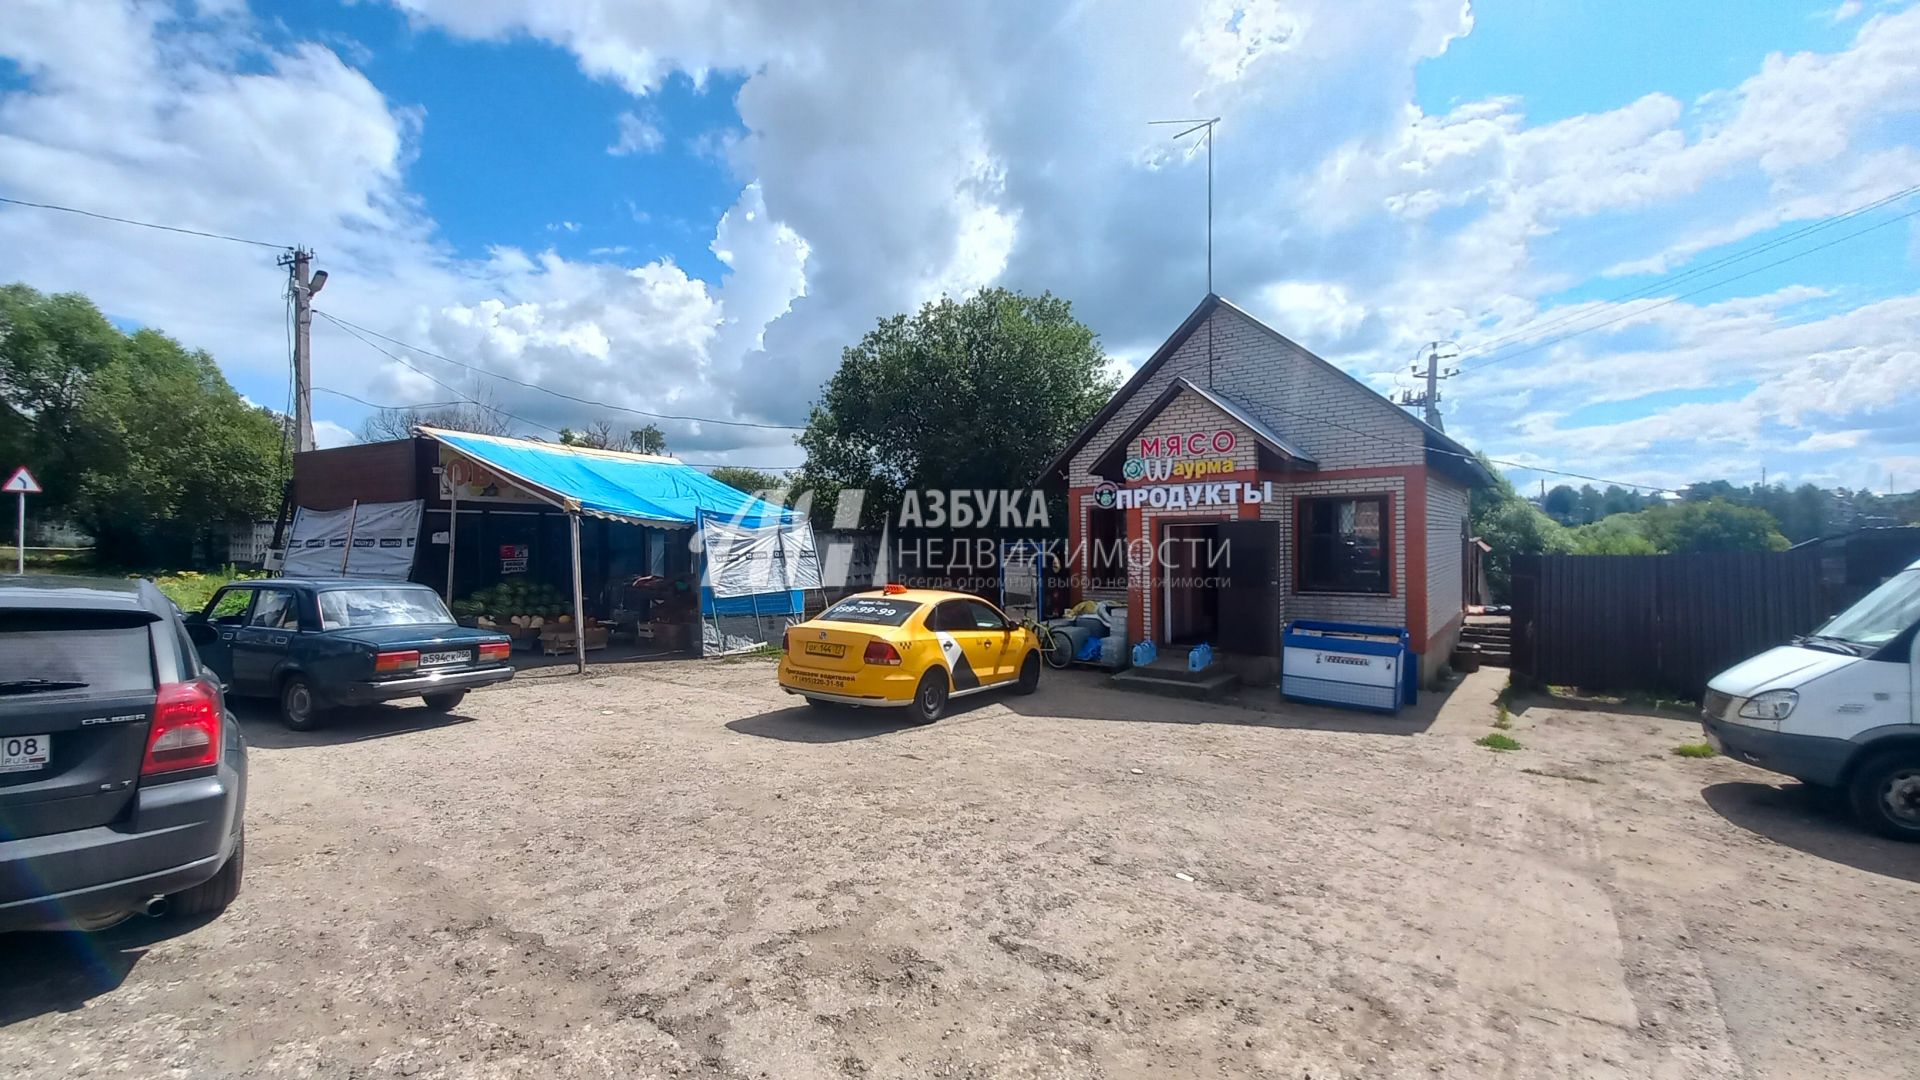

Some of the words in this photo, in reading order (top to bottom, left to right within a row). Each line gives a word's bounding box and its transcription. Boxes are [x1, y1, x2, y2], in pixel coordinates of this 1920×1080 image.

[1140, 430, 1235, 458] МЯСО
[1144, 458, 1233, 482] Шаурма
[1115, 482, 1272, 510] ПРОДУКТЫ
[82, 714, 145, 725] CALIBER
[7, 738, 38, 757] 08
[5, 756, 28, 765] RUS
